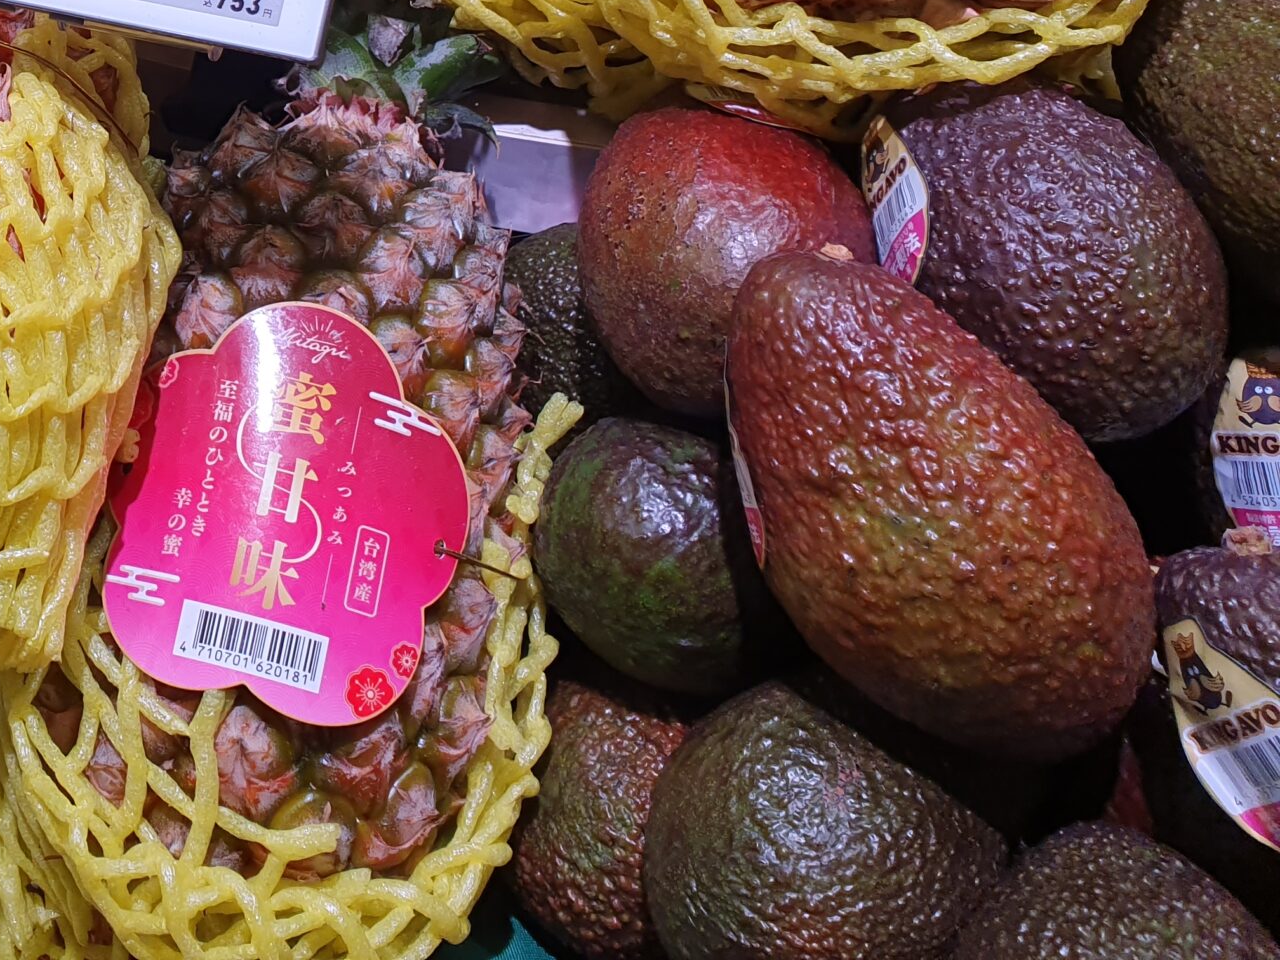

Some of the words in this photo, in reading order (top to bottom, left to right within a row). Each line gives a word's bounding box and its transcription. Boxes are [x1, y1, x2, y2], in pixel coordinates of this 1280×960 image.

[190, 379, 239, 538] 至福のひととき
[228, 371, 337, 611] 蜜甘味
[161, 487, 194, 557] 幸の蜜
[327, 460, 358, 547] みつあみ
[1241, 495, 1280, 508] 52405
[353, 536, 381, 606] 台湾産
[179, 643, 187, 653] 4
[198, 644, 249, 669] 710701
[255, 661, 310, 686] 620181
